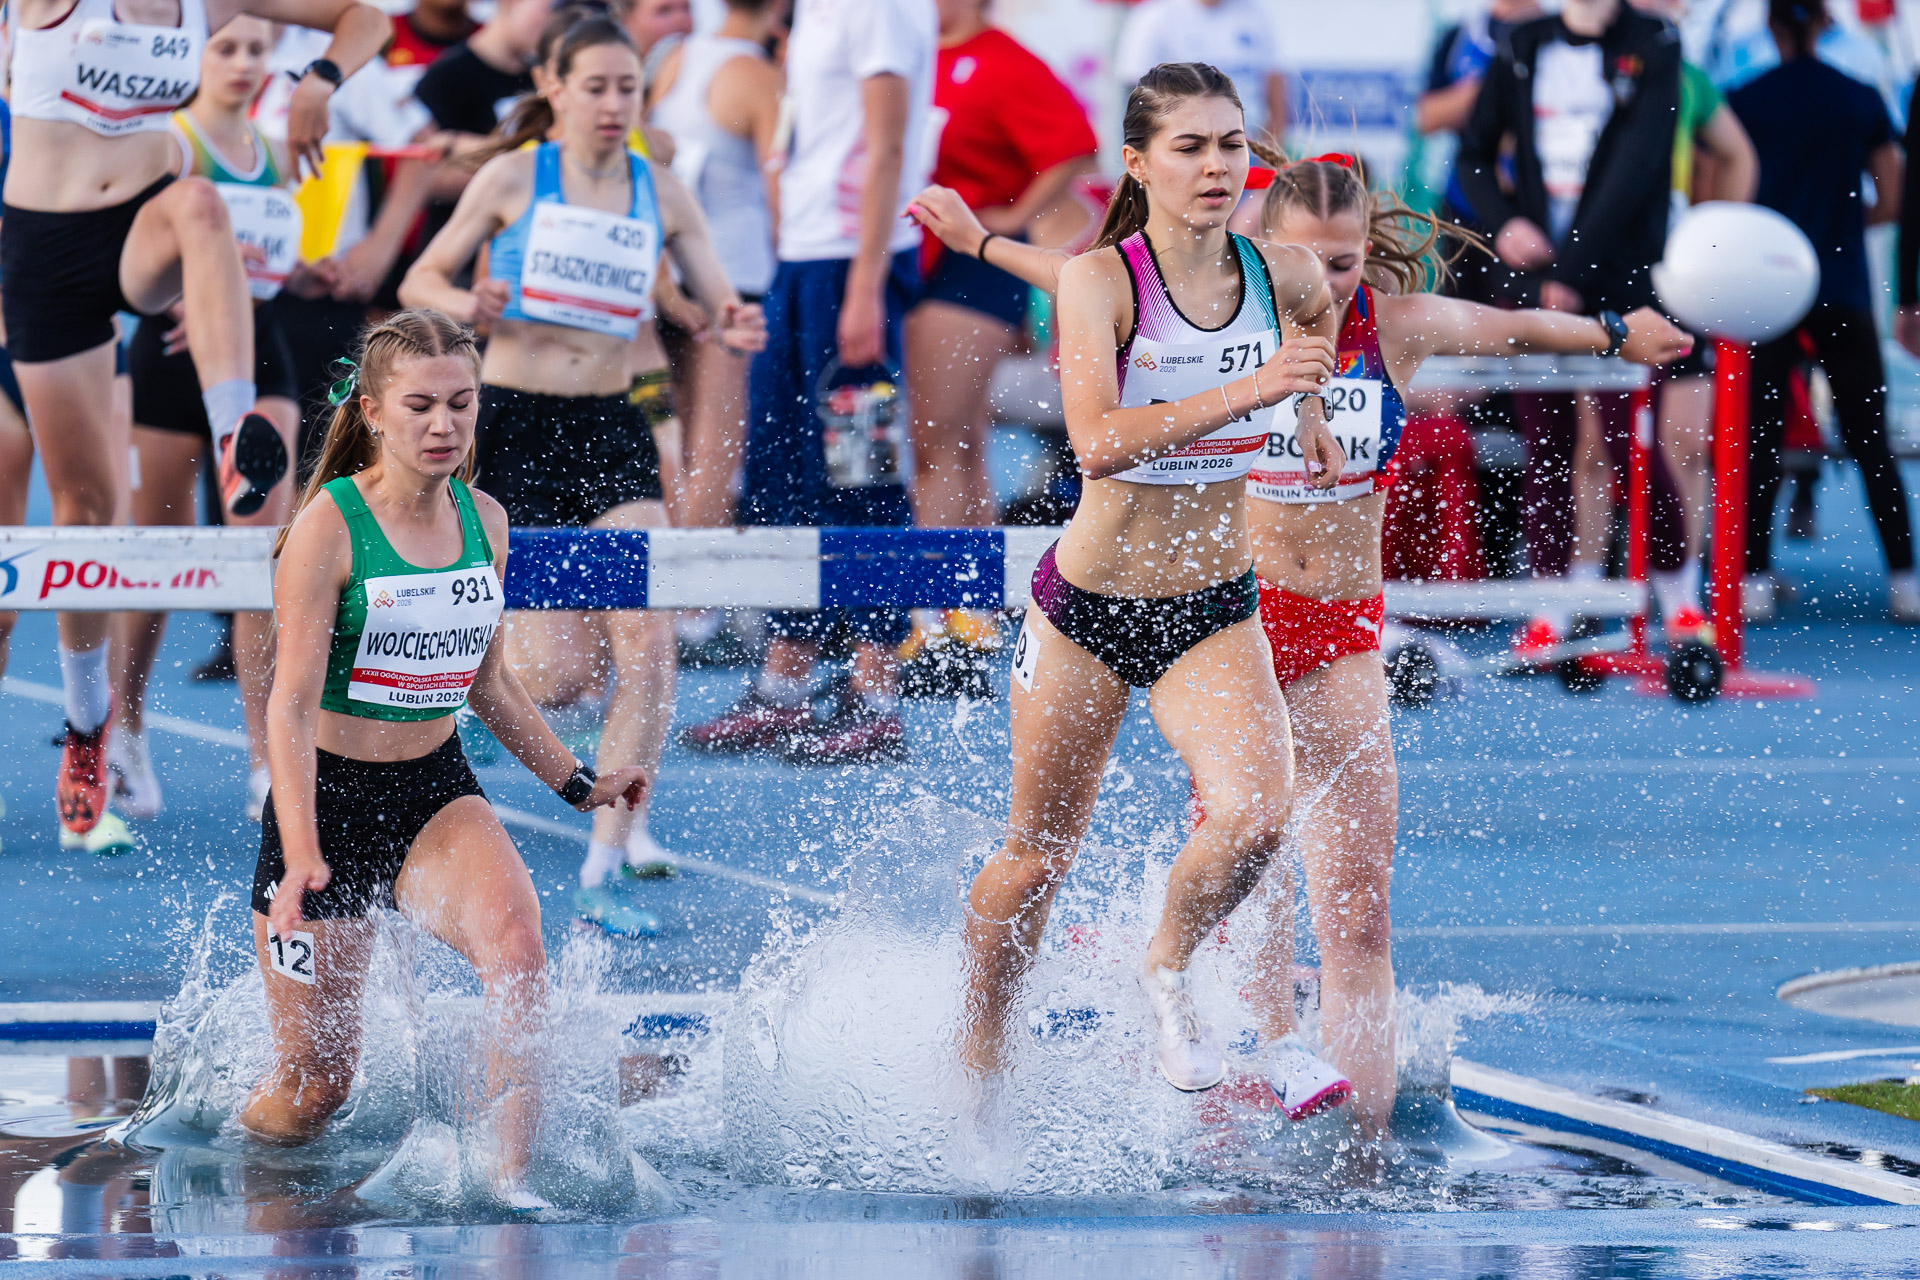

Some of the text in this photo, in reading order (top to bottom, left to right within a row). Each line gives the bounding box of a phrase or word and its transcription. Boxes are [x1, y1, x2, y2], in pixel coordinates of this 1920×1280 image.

[151, 34, 190, 59] 849
[78, 63, 190, 99] WASZAK
[606, 225, 644, 249] 420
[530, 249, 647, 296] STASZKIEWICZ
[1160, 355, 1205, 365] LUBELSKIE
[1218, 341, 1266, 374] 571
[1159, 365, 1177, 373] 2026
[1152, 458, 1234, 471] LUBLIN 2026
[1255, 486, 1301, 499] LUBLIN
[396, 586, 437, 598] LUBELSKIE
[451, 575, 495, 606] 931
[396, 599, 412, 607] 2026
[366, 623, 493, 661] WOJCIECHOWSKA
[361, 669, 379, 677] XXXII
[379, 671, 432, 684] OGÓLNOPOLSKA
[406, 681, 439, 690] SPORTACH
[438, 680, 464, 689] LETNICH
[388, 691, 465, 704] LUBLIN 2026
[269, 932, 313, 976] 12
